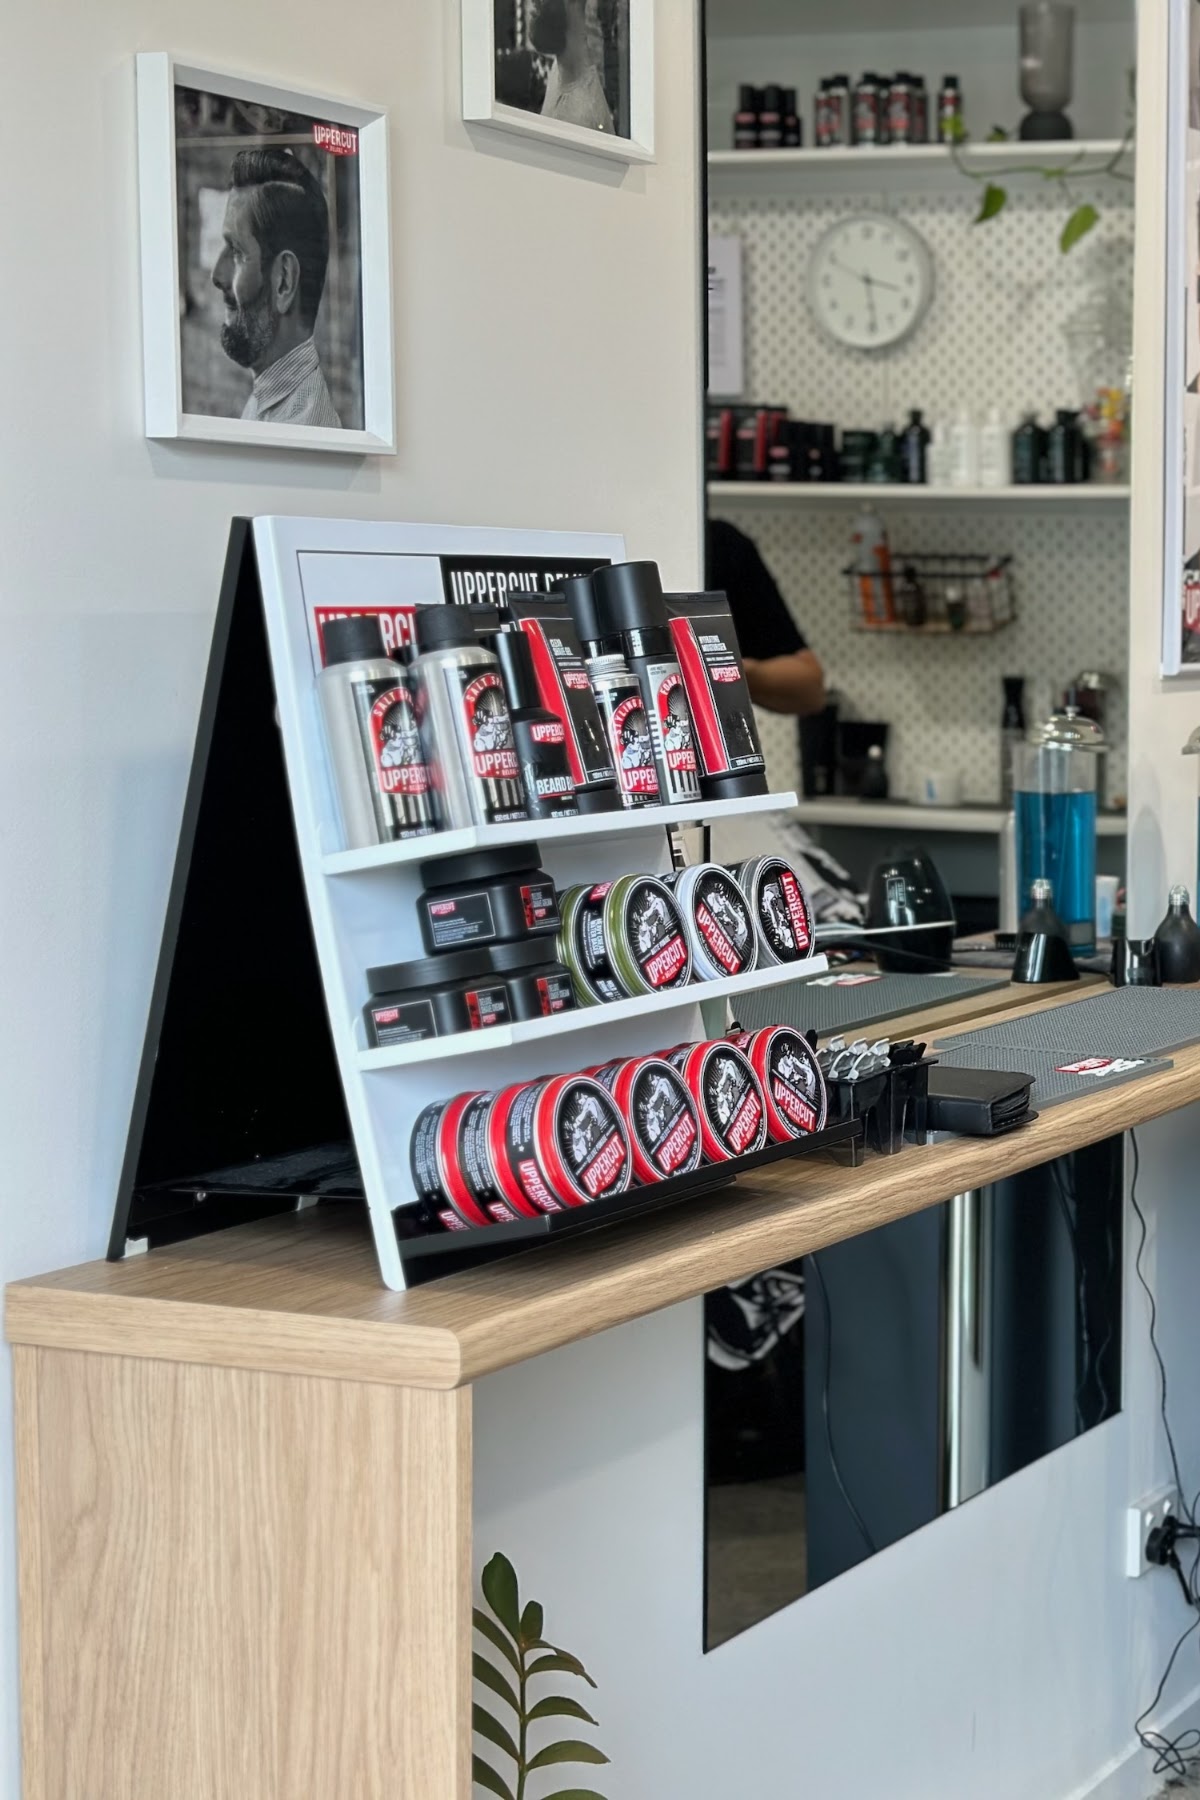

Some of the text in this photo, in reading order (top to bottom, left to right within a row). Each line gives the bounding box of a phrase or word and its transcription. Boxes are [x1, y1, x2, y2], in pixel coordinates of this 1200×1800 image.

[314, 125, 357, 152] UPPERCUT
[372, 691, 397, 717] SALT
[467, 676, 488, 701] SALT
[536, 777, 567, 794] BEARD
[782, 874, 809, 948] UPPERCUT
[646, 938, 687, 984] UPPERCUT
[698, 905, 740, 971] UPPERCUT
[729, 1093, 761, 1151] UPPERCUT
[774, 1080, 815, 1130] UPPERCUT
[583, 1137, 625, 1192] UPPERCUT
[658, 1116, 697, 1170] UPPERCUT
[520, 1161, 563, 1212] UPPERCUT
